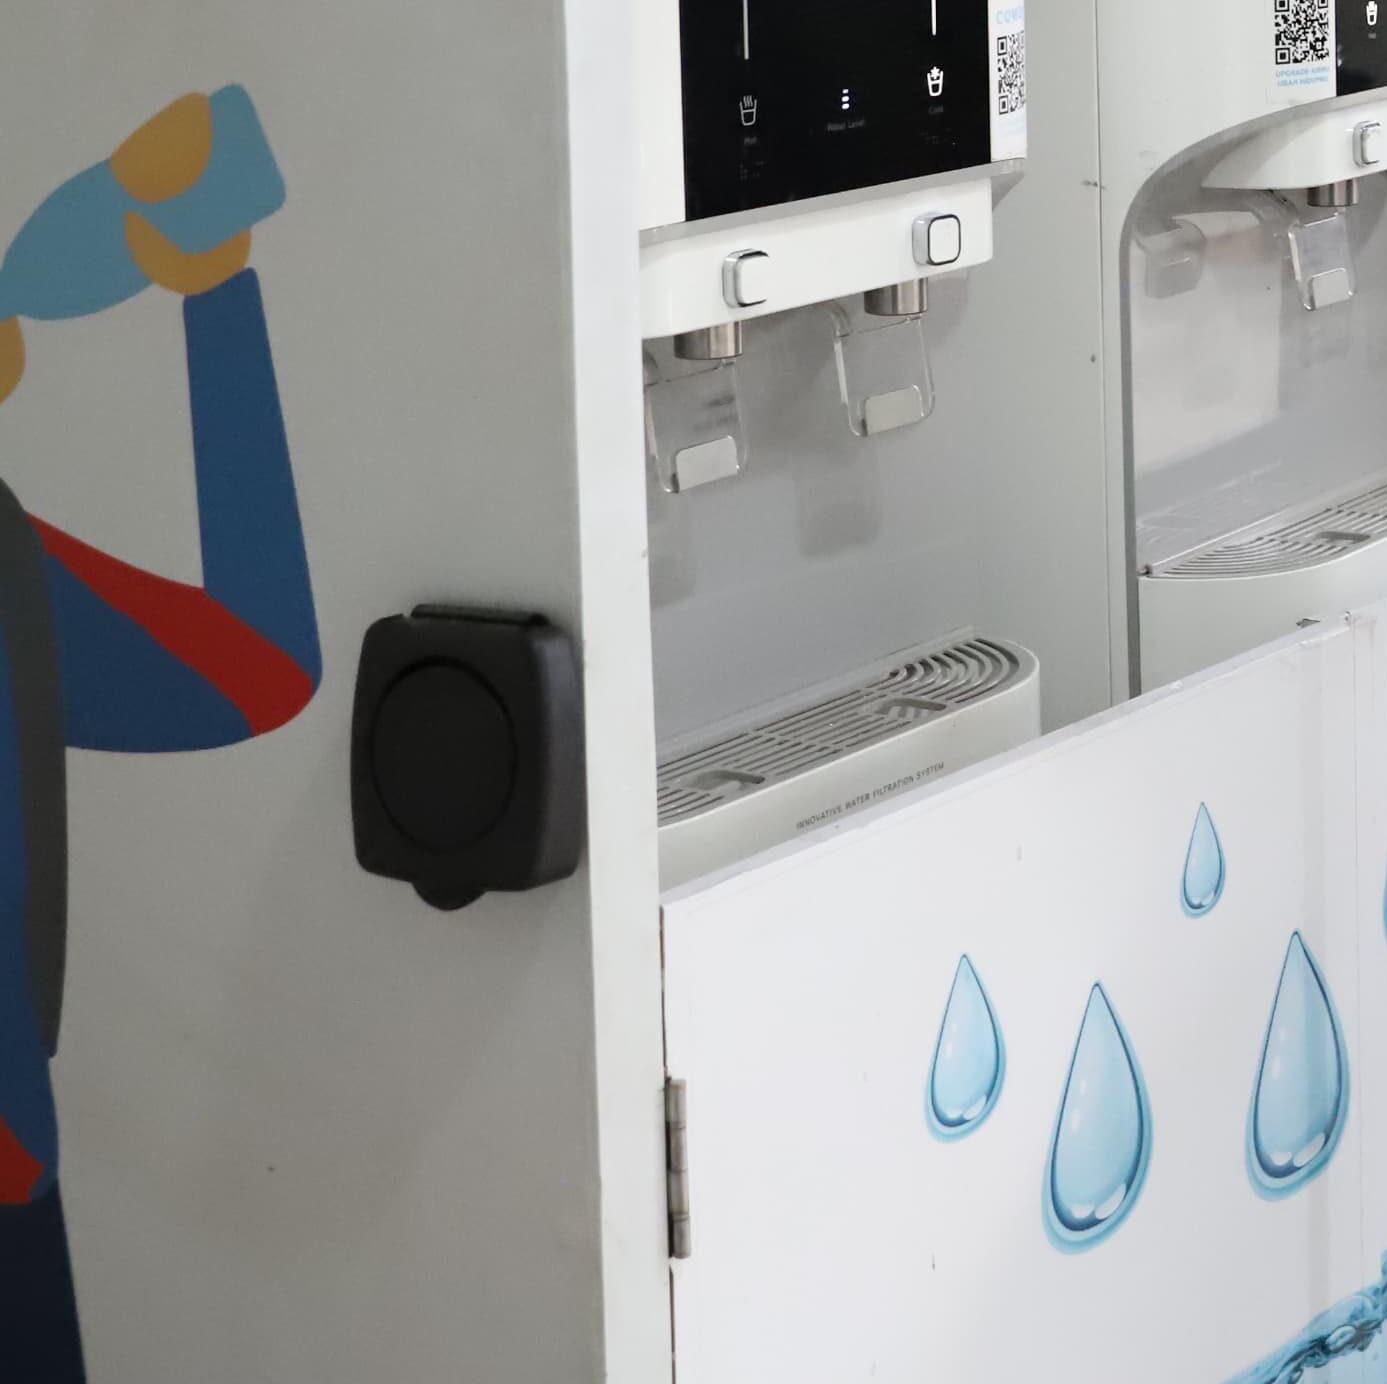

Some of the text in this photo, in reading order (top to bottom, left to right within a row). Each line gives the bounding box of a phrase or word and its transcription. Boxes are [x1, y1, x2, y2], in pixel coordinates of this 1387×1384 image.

[996, 6, 1025, 26] cow
[845, 793, 870, 810] WATER
[872, 776, 914, 798] FILTRATION
[916, 761, 945, 780] SYSTEM
